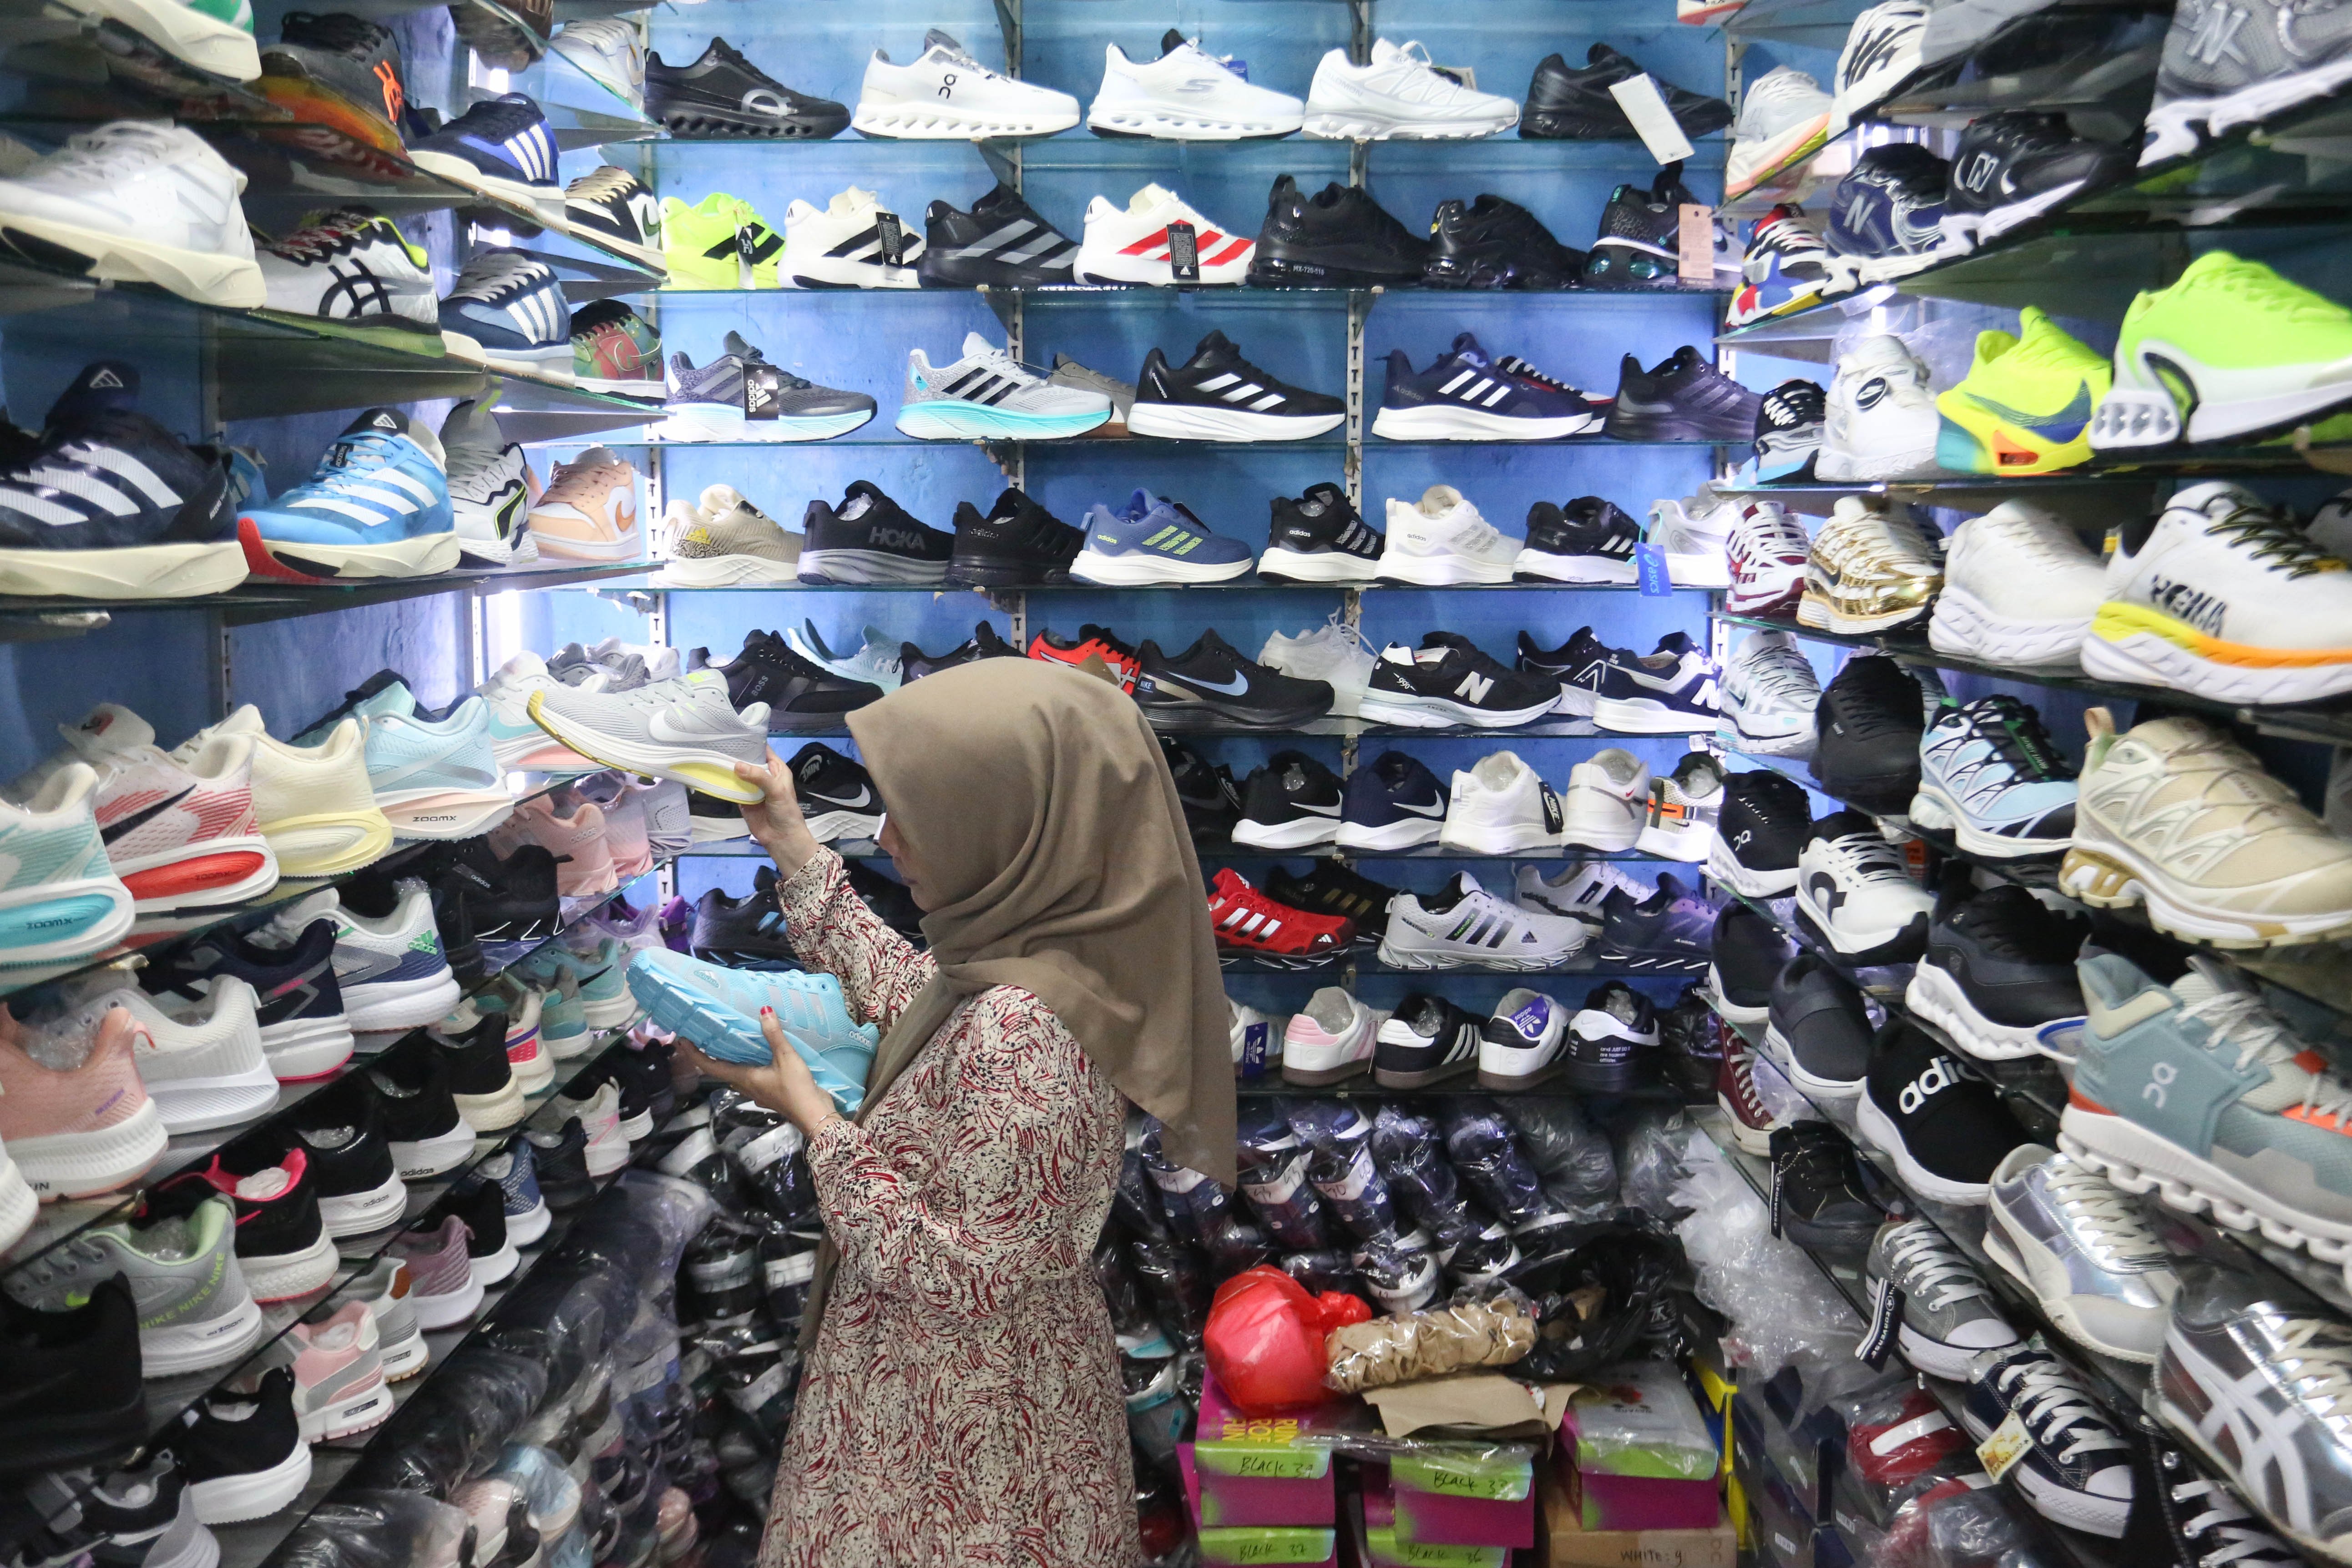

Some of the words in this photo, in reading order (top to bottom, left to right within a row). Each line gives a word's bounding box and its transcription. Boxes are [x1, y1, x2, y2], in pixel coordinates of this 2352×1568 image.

[1843, 194, 1876, 236] N
[747, 379, 756, 413] adidas
[1401, 389, 1424, 402] adidas
[869, 526, 926, 550] HOKA
[1098, 534, 1117, 544] adidas
[1648, 567, 1659, 594] asics
[752, 676, 769, 696] BOSS
[1140, 680, 1152, 689] NIKE
[1454, 672, 1494, 704] N
[1548, 797, 1560, 821] NIKE
[471, 874, 491, 888] adidas
[407, 942, 438, 955] adidas
[1514, 1008, 1532, 1022] adidas
[849, 1030, 873, 1049] adidas
[401, 1168, 434, 1177] adidas
[363, 1195, 390, 1208] adidas
[209, 1252, 226, 1285] NIKE
[178, 1286, 211, 1313] NIKE
[1274, 1418, 1298, 1444] RUN
